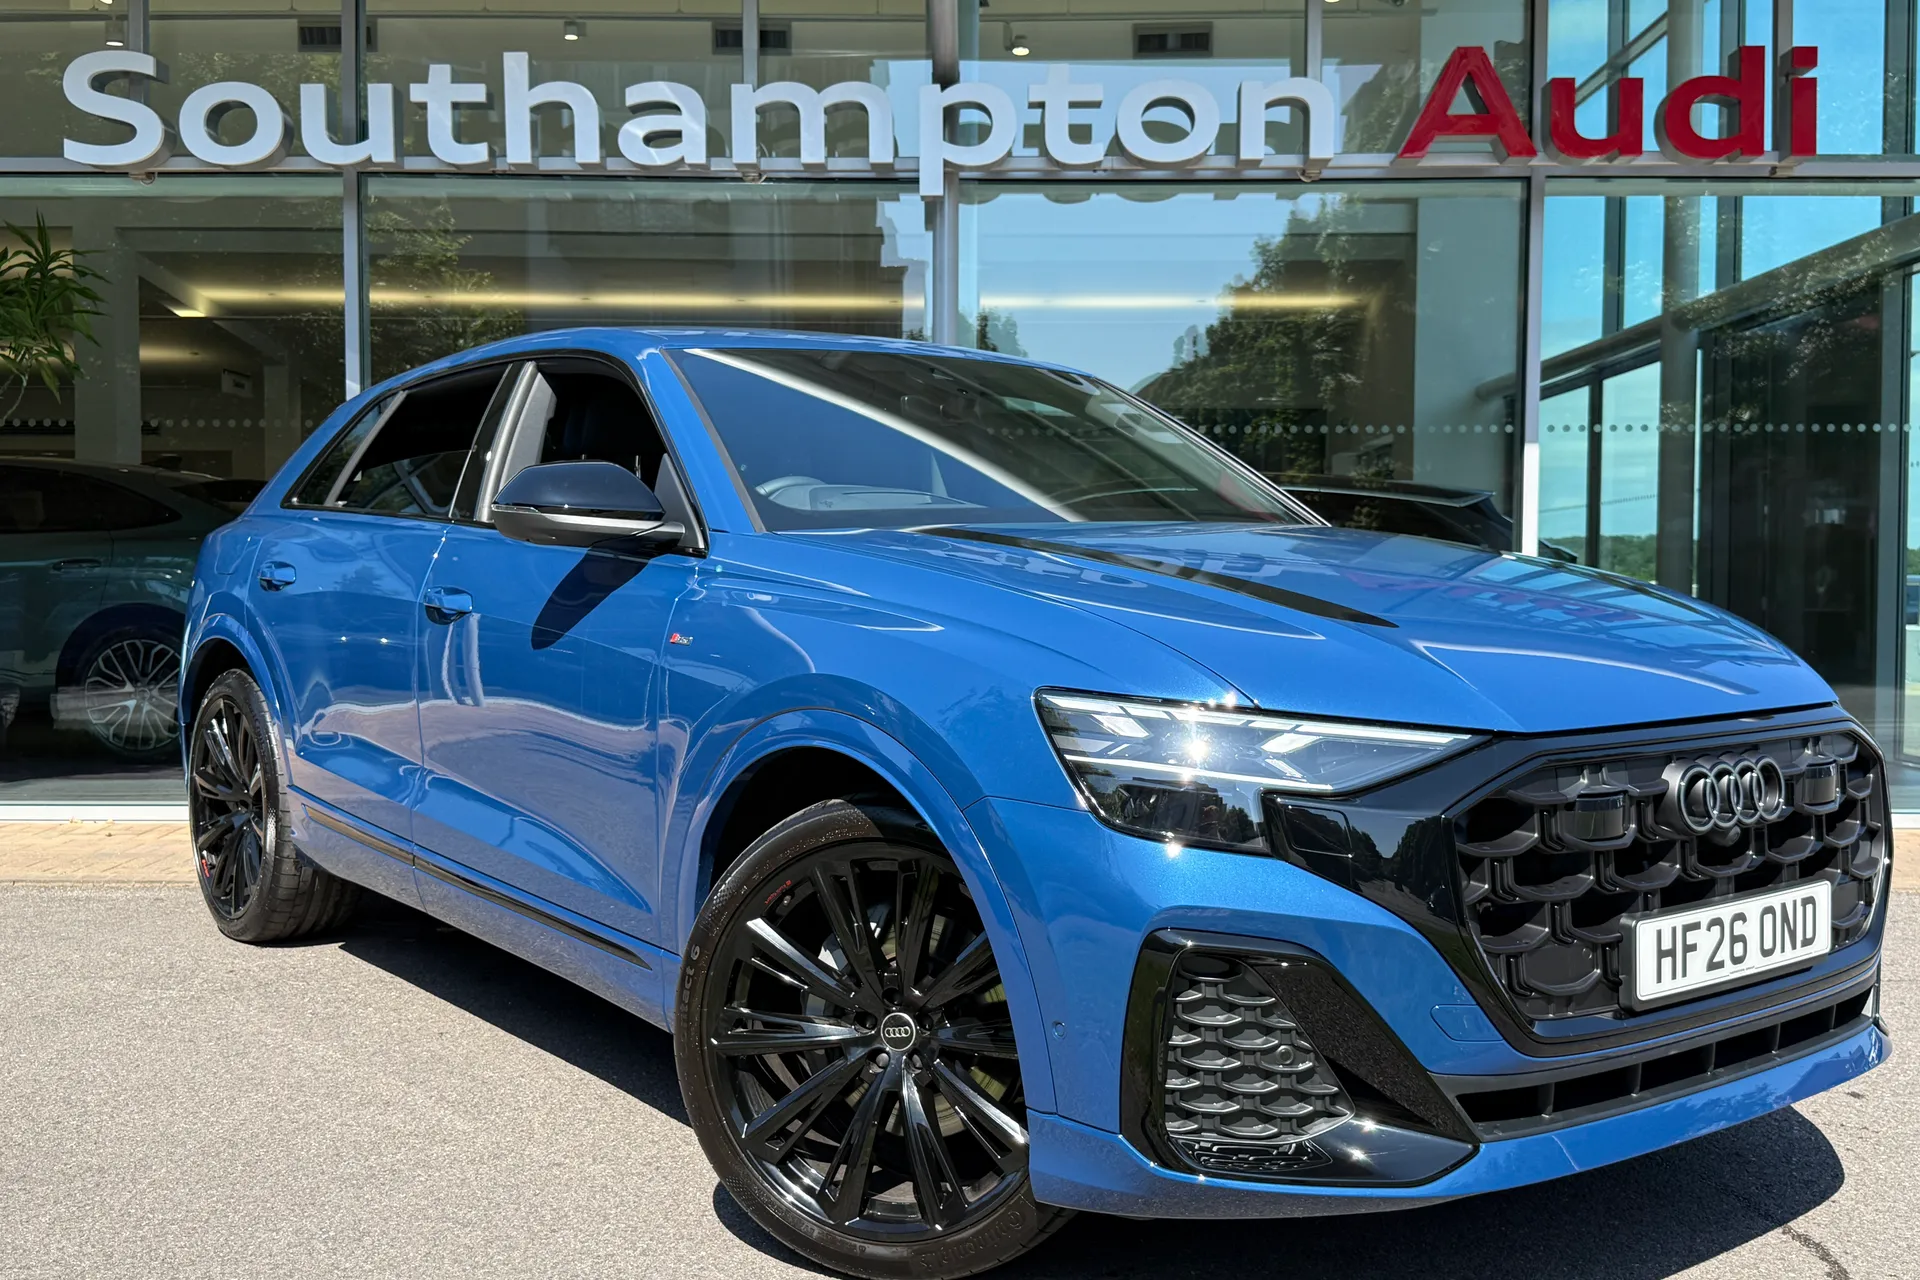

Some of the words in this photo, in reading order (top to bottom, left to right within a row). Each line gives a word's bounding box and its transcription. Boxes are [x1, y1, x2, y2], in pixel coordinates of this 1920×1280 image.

[62, 50, 1335, 196] Southampton
[1400, 46, 1818, 160] Audi
[1656, 911, 1748, 984] HF26
[1759, 895, 1817, 958] OND
